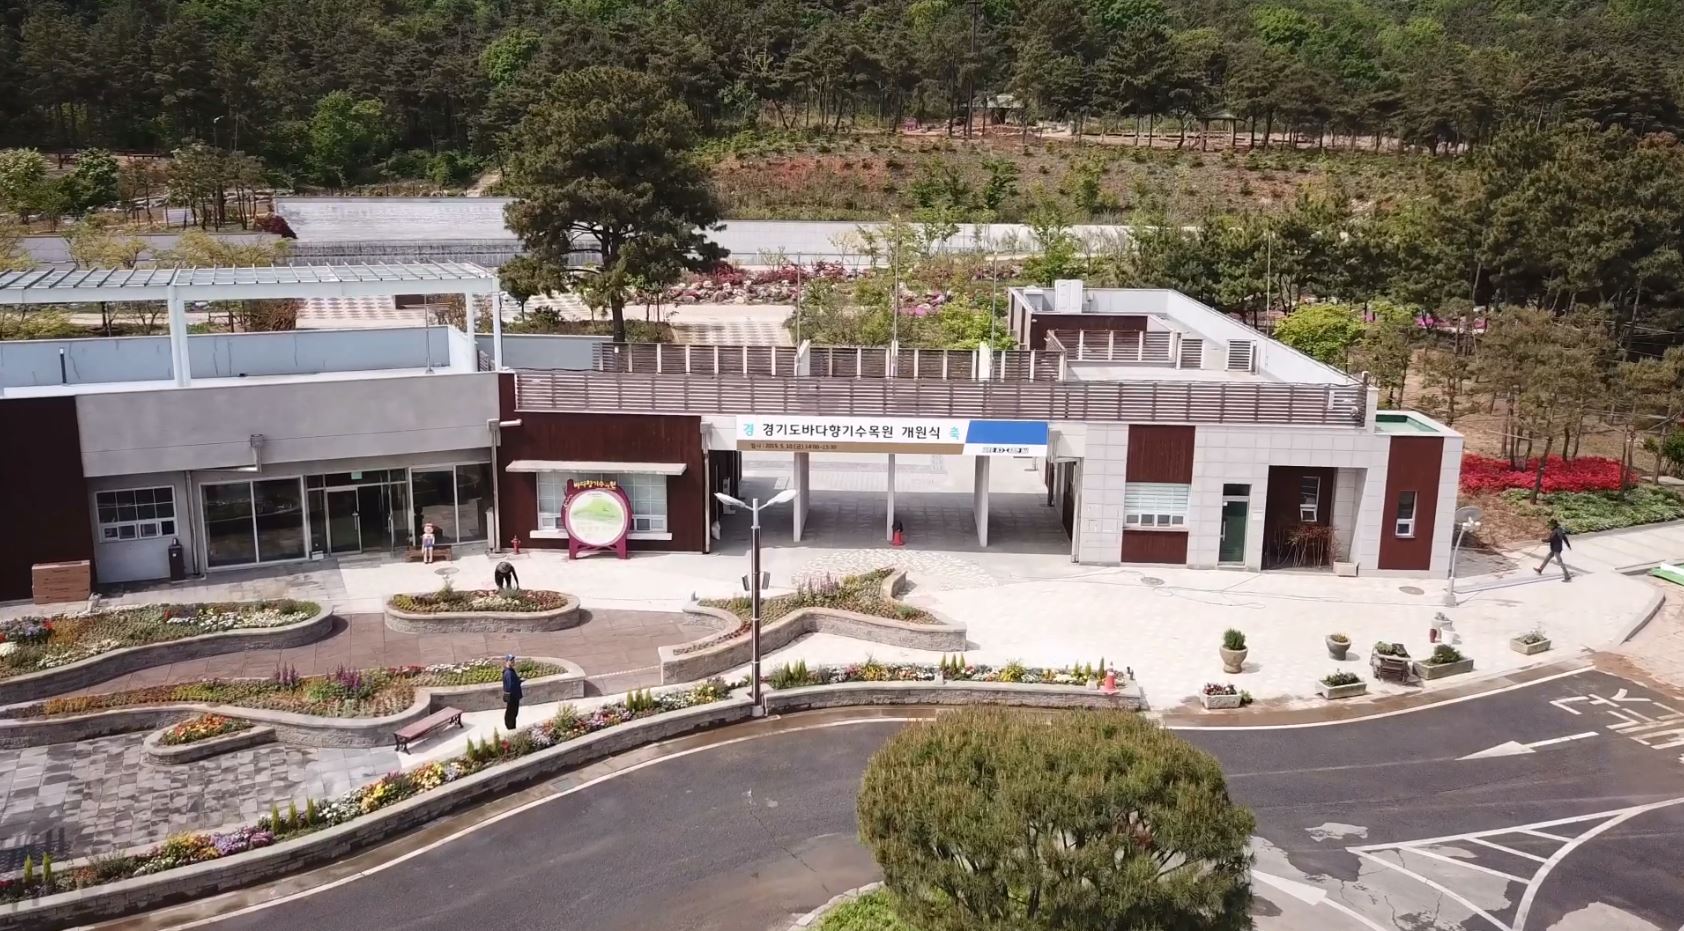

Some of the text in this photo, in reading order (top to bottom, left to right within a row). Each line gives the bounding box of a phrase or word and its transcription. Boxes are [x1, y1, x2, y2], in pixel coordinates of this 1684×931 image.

[744, 424, 754, 436] 경
[763, 423, 894, 438] 경기도바다향기수목원
[902, 425, 941, 440] 개원식
